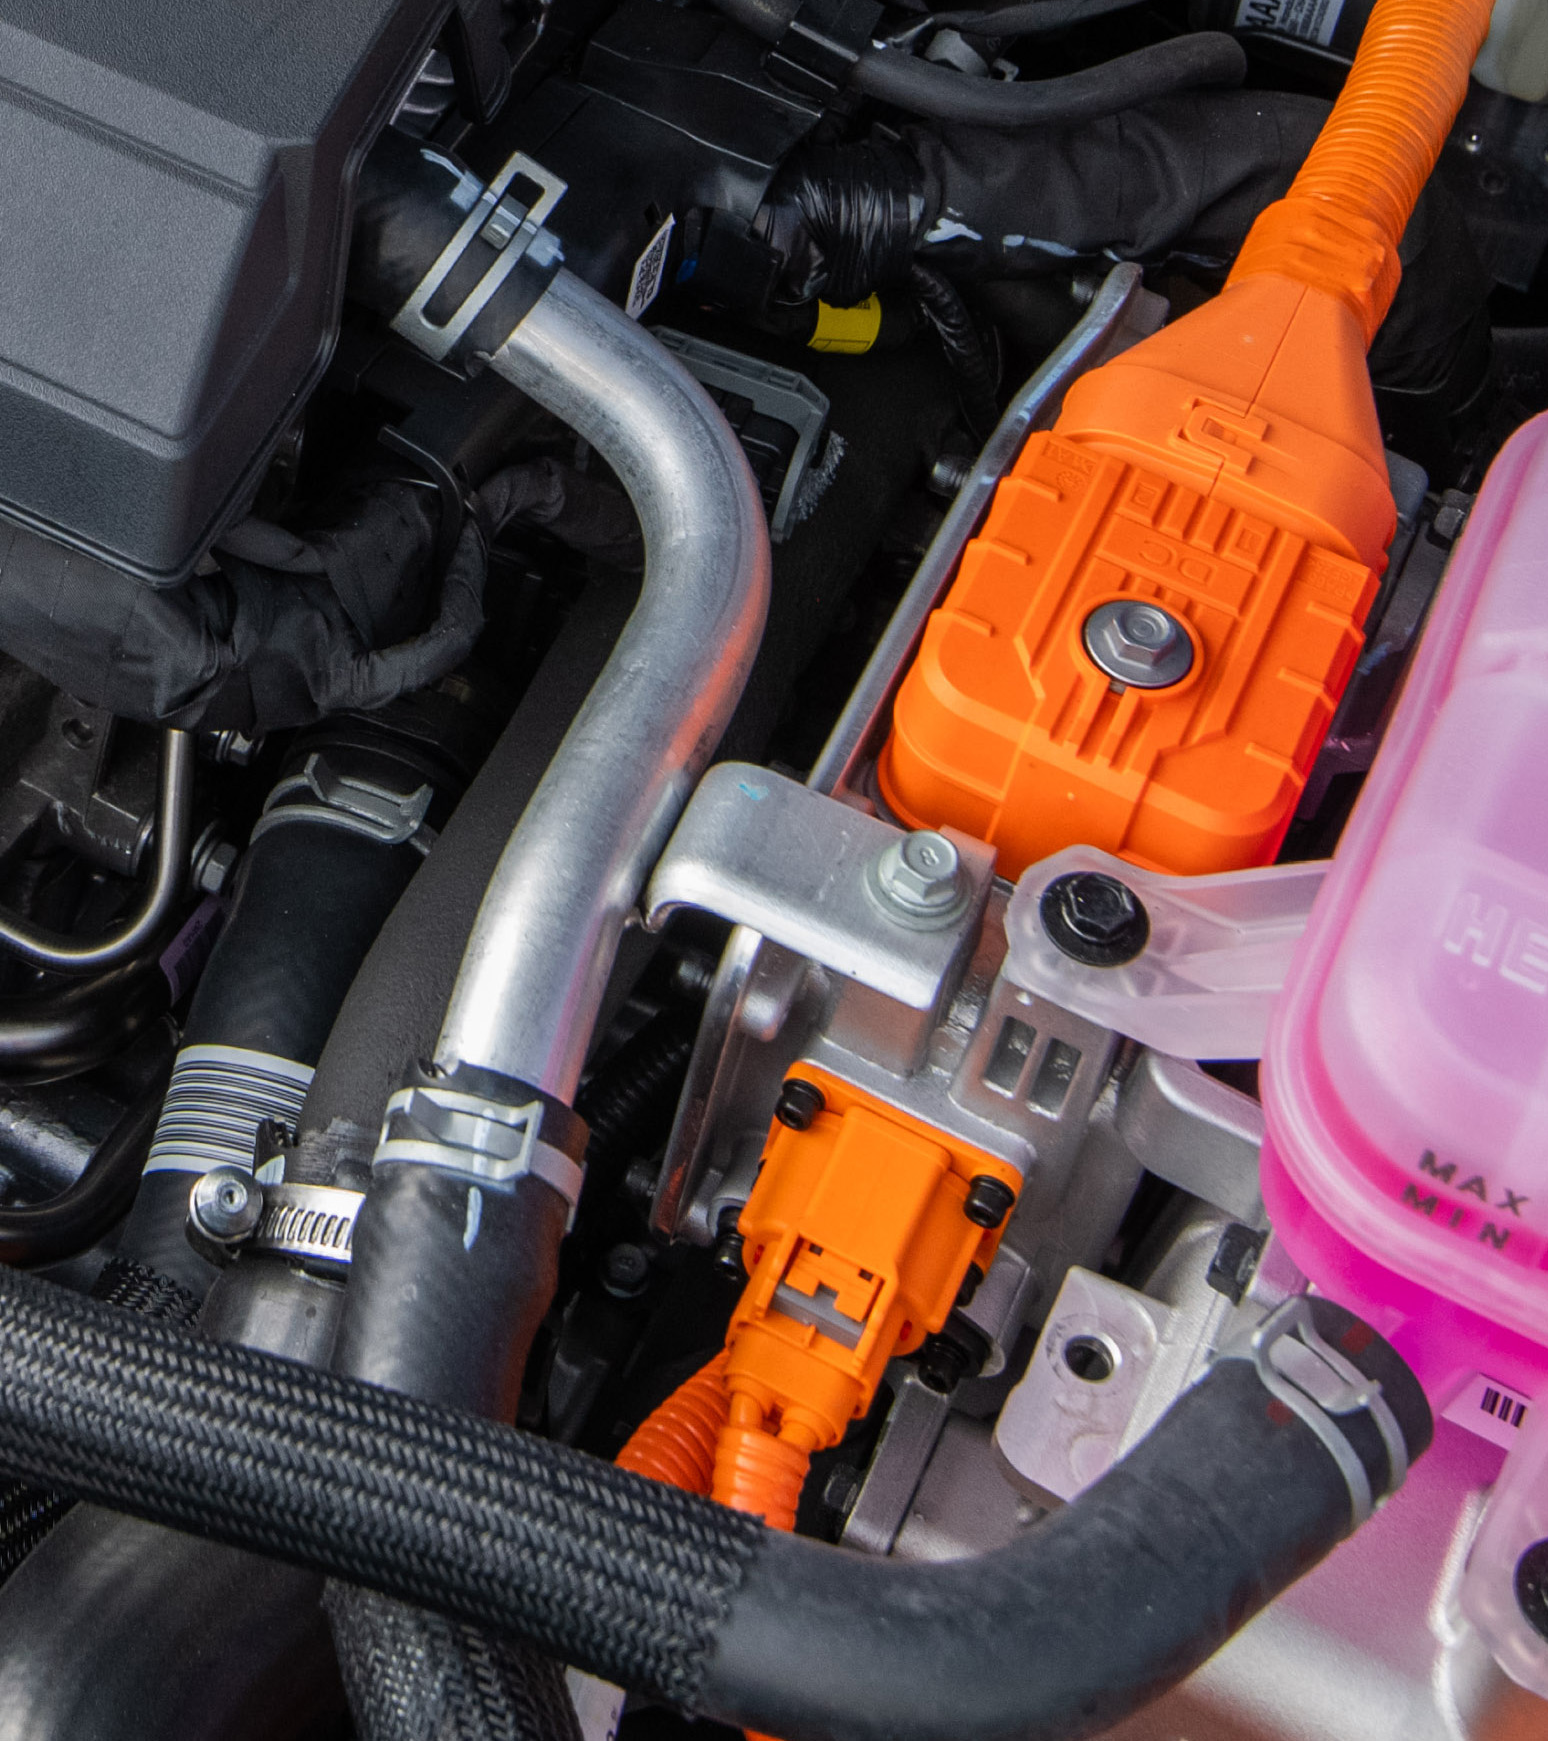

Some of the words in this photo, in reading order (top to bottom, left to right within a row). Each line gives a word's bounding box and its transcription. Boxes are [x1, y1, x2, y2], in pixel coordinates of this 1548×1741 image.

[1136, 535, 1218, 589] DC
[1401, 1182, 1510, 1250] MIN
[1418, 1148, 1530, 1218] MAX
